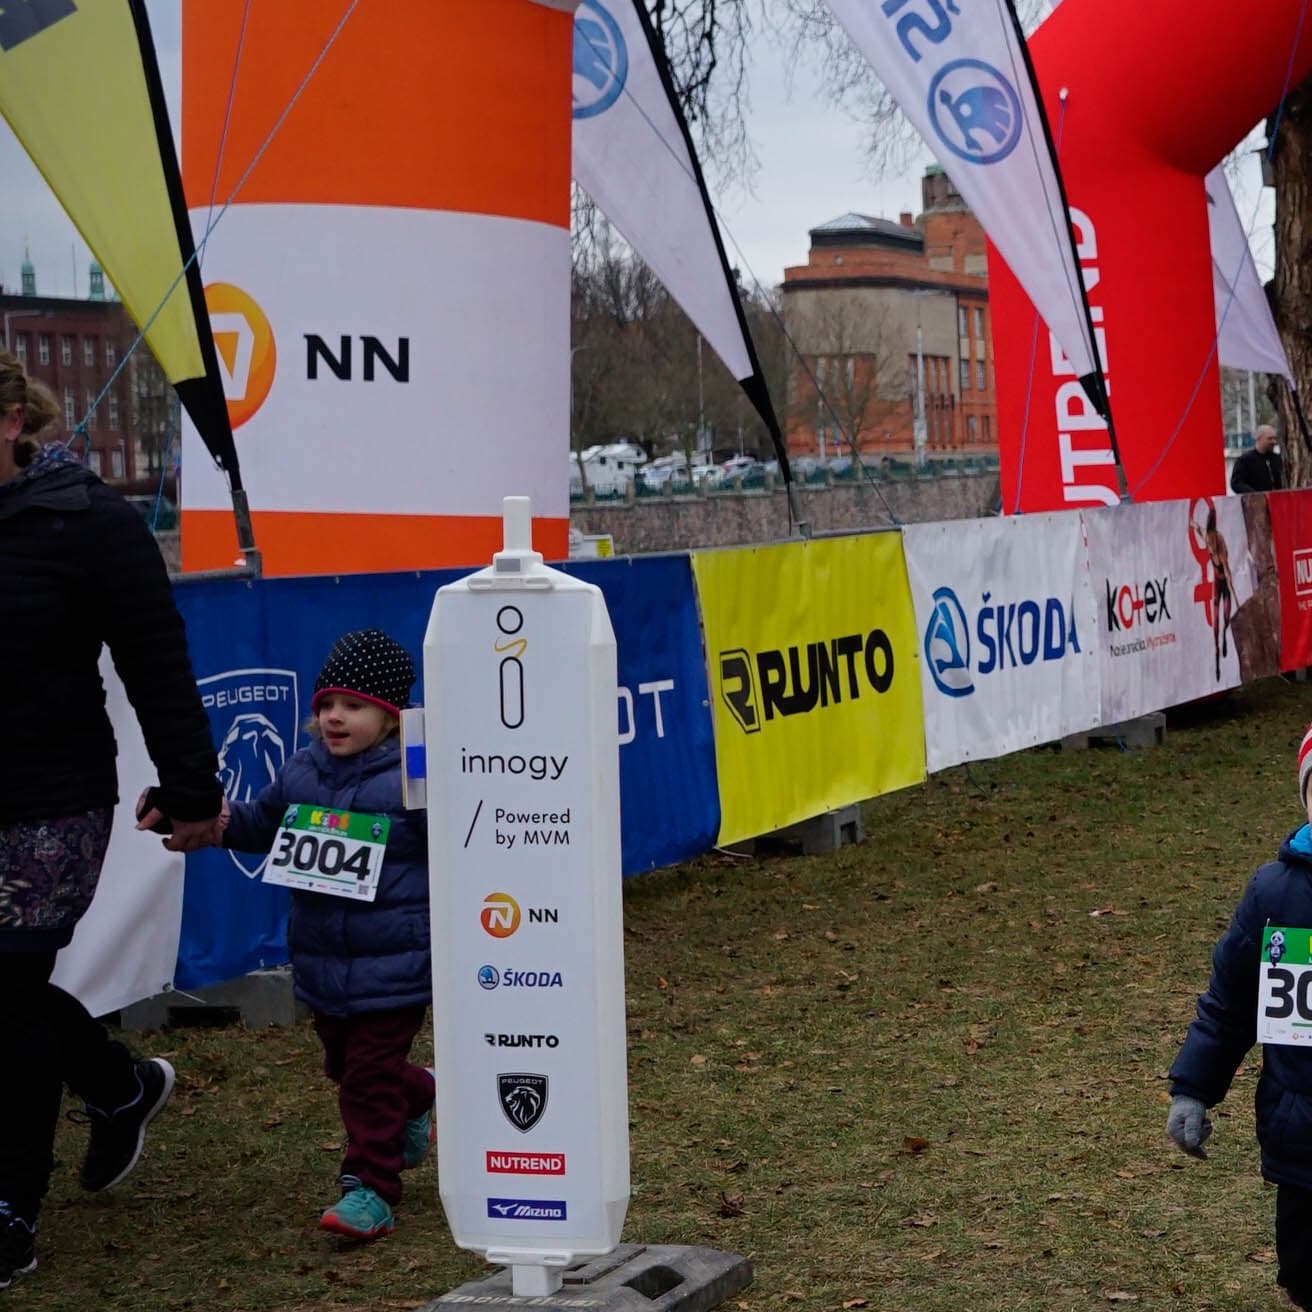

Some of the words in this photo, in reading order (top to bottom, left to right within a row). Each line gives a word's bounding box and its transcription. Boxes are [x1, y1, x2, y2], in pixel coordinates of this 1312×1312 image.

[303, 333, 410, 383] NN
[1105, 577, 1171, 632] kotex
[976, 592, 1081, 675] ŠKODA
[756, 629, 894, 721] RUNTO
[201, 685, 290, 708] PEUGEOT
[461, 747, 568, 780] innogy
[495, 808, 570, 824] Powered
[495, 829, 516, 848] by
[524, 830, 570, 845] MVM
[272, 831, 371, 881] 3004
[528, 908, 559, 923] NN
[502, 969, 563, 987] ŠKODA
[498, 1034, 560, 1048] RUNTO
[501, 1077, 544, 1086] PEUGEOT
[490, 1155, 562, 1172] NUTREND
